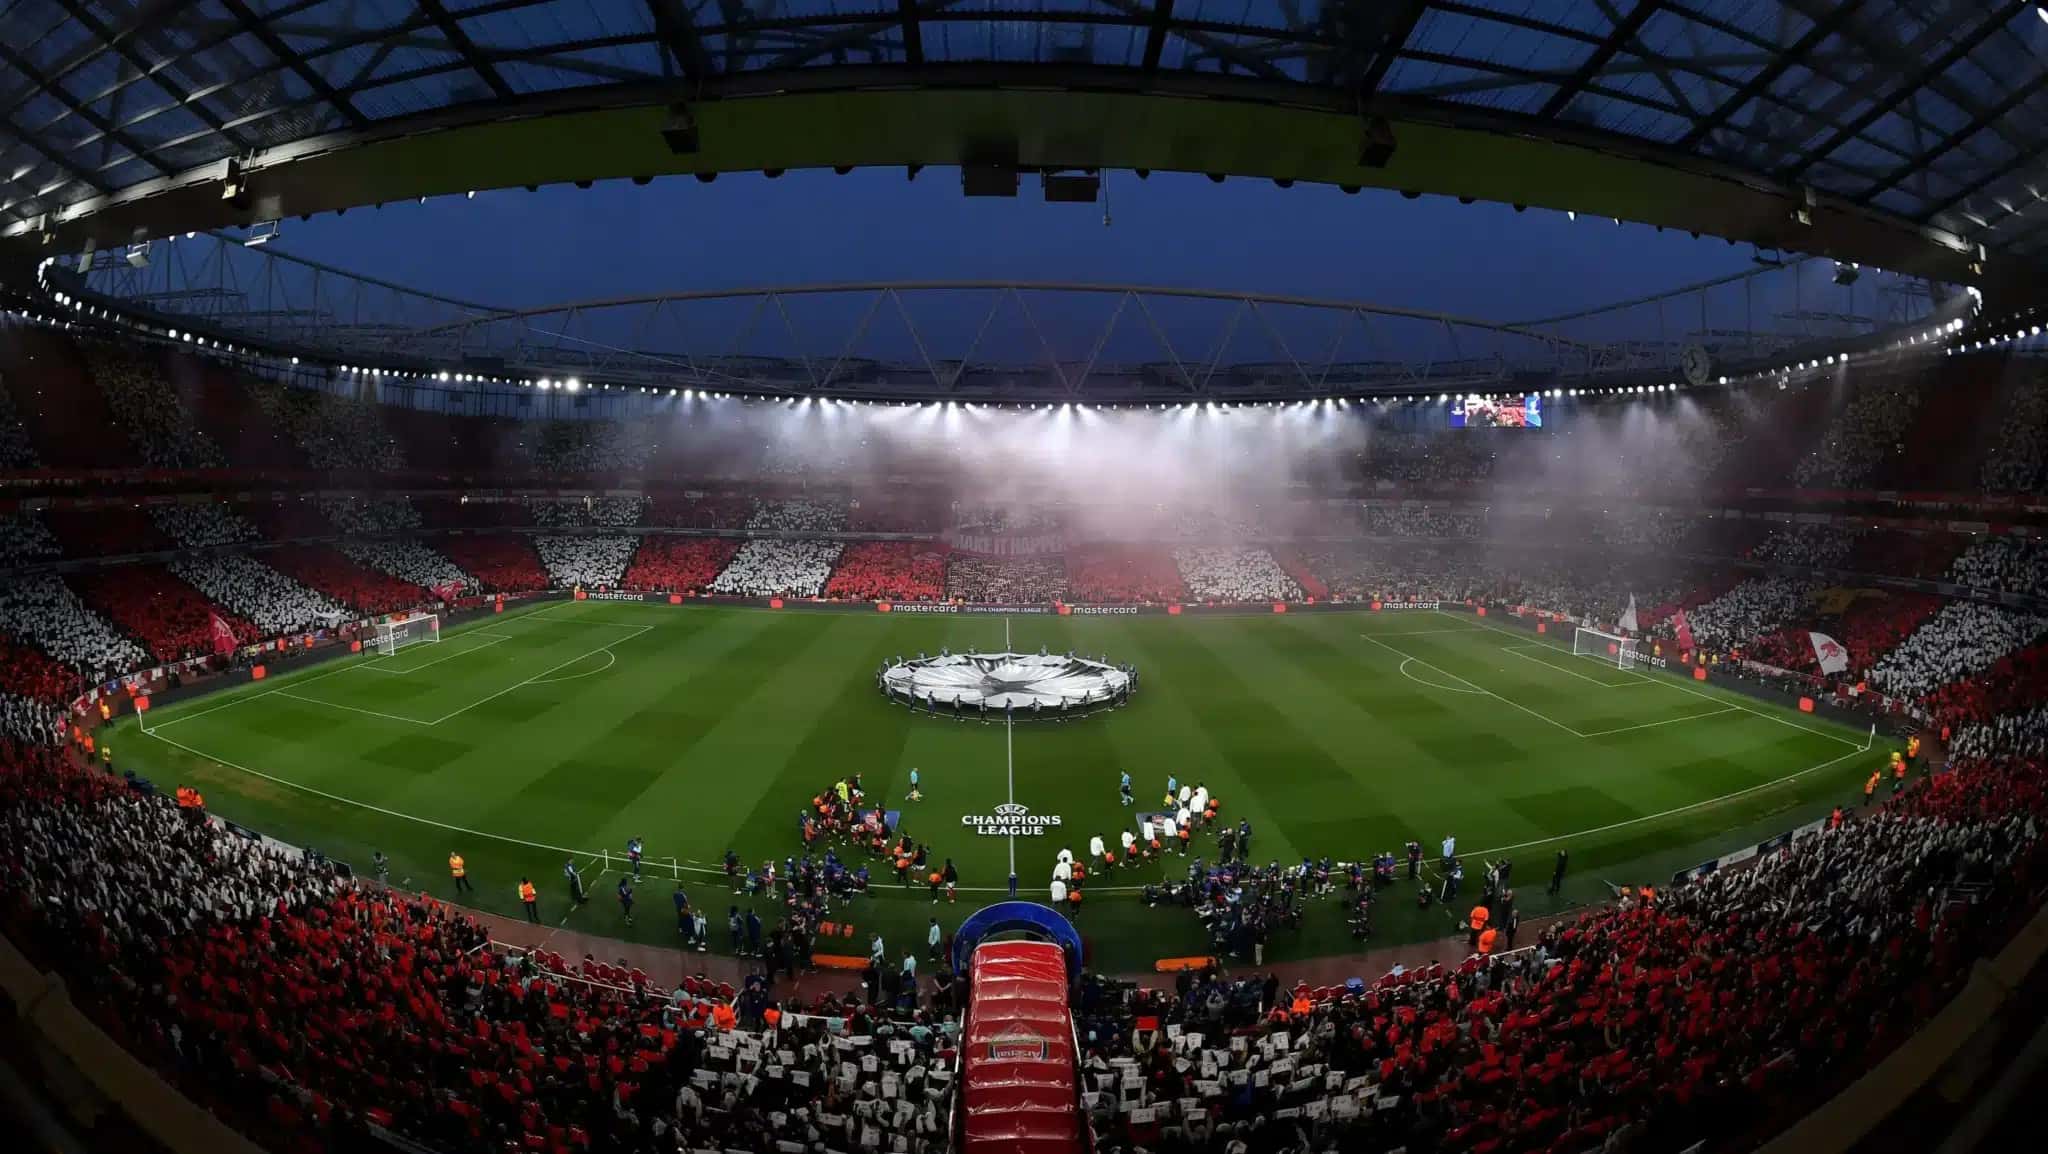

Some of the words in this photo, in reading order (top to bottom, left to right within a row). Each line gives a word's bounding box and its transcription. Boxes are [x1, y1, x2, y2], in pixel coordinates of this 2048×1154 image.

[588, 592, 644, 601] mastercard
[893, 603, 958, 613] mastercard
[1073, 605, 1137, 614] mastercard
[1384, 601, 1439, 609] mastercard
[363, 629, 409, 648] mastercard
[995, 805, 1027, 815] UEFA
[961, 815, 1062, 825] CHAMPIONS
[977, 825, 1045, 835] LEAGUE
